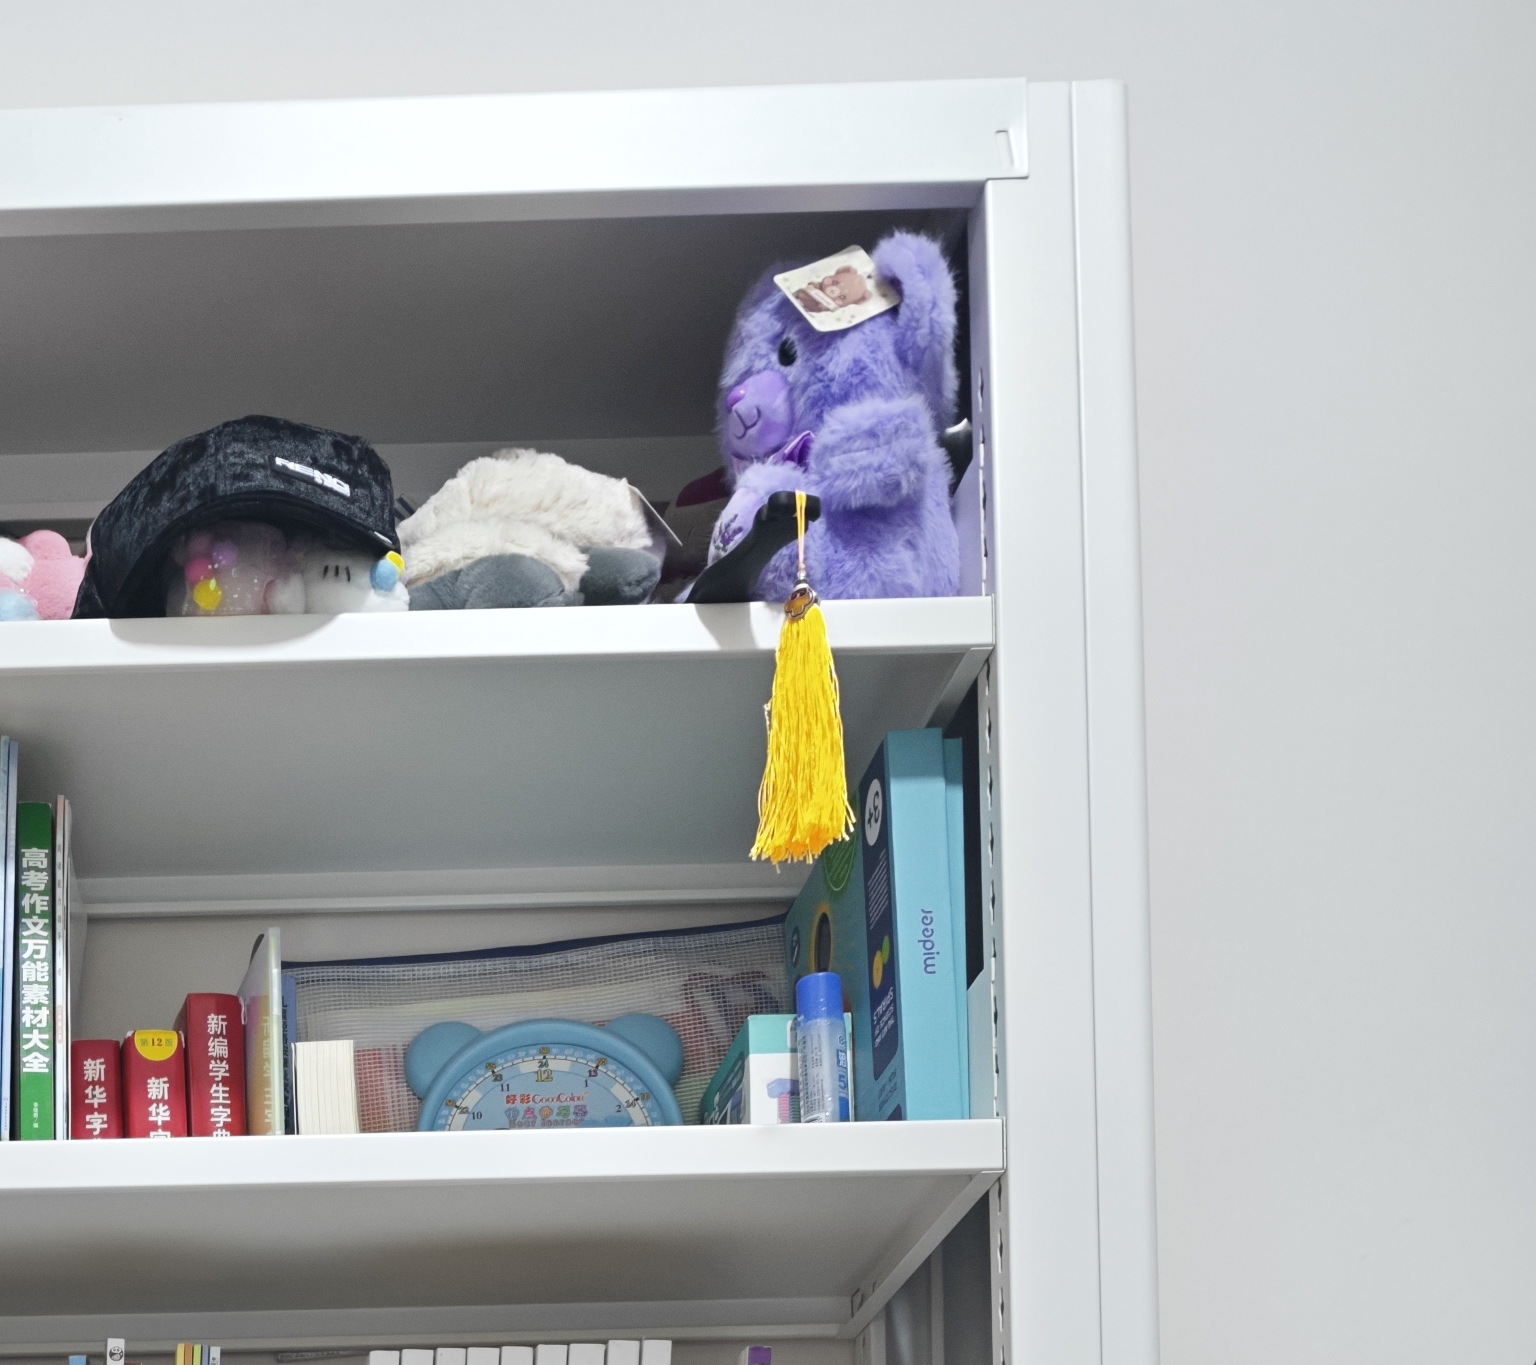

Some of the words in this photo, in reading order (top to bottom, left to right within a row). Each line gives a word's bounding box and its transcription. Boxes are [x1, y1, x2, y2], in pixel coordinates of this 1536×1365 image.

[21, 847, 50, 1073] 高考作文万能素材大全
[917, 908, 940, 975] mideer
[500, 1083, 510, 1092] 11
[535, 1069, 553, 1082] 12
[83, 1058, 108, 1140] 新华字
[471, 1111, 482, 1120] 10
